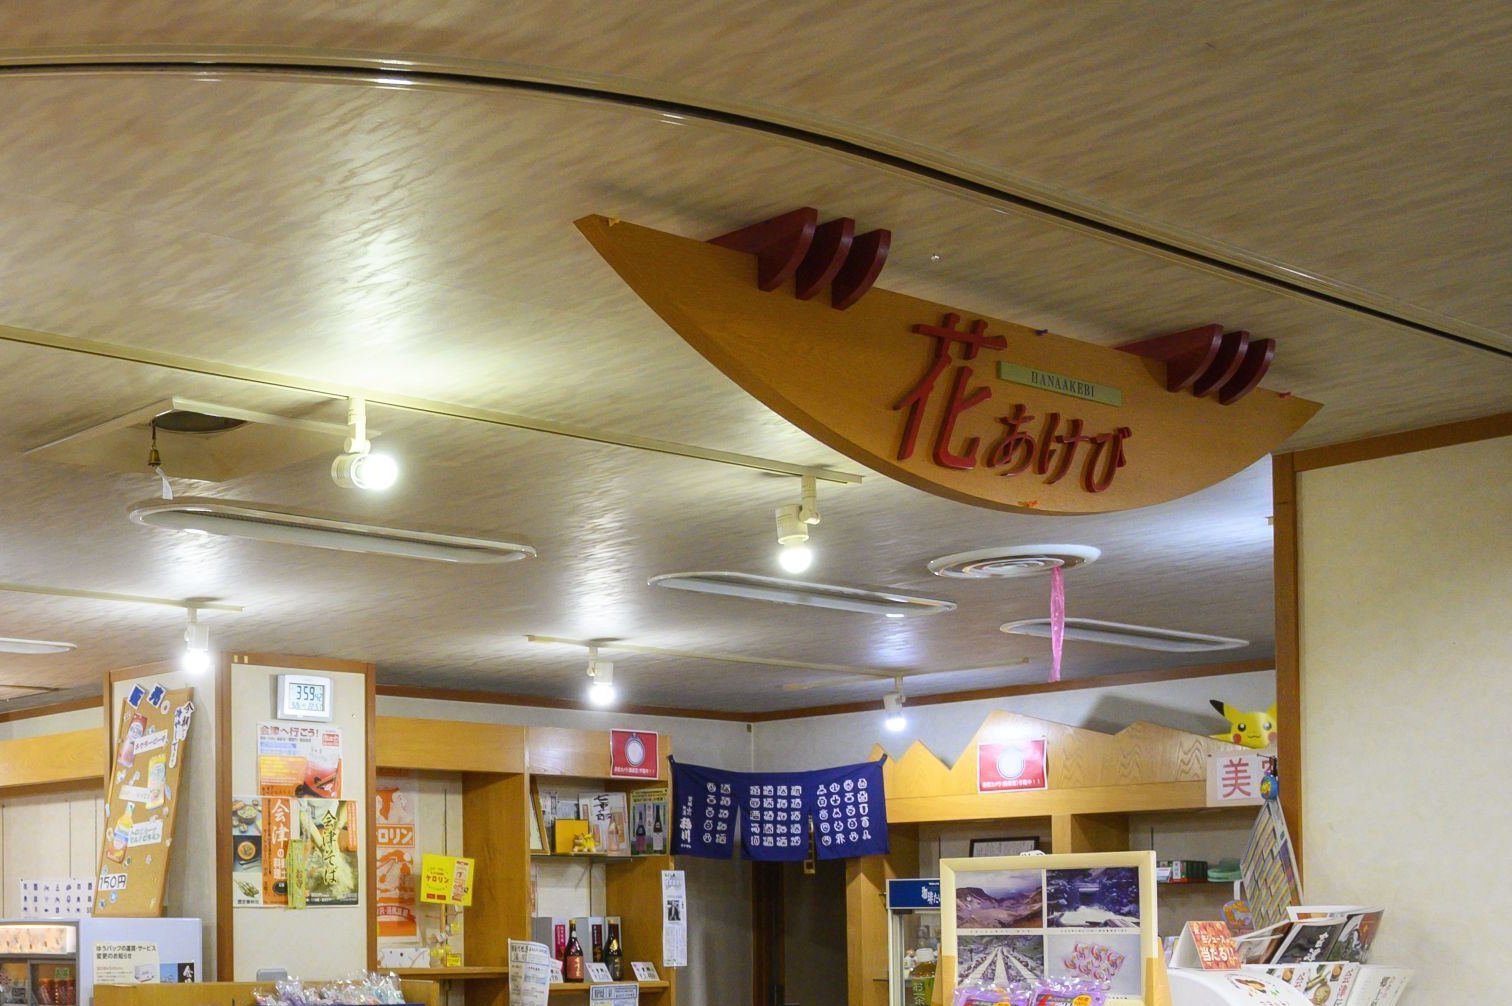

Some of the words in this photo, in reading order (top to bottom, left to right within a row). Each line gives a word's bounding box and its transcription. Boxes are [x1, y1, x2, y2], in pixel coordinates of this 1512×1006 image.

[1031, 370, 1095, 398] HANAAKEBI
[892, 312, 1132, 493] 花あけび
[322, 809, 337, 885] 会津そば
[376, 827, 414, 846] ロリン
[100, 874, 127, 889] 150円
[96, 952, 132, 960] 変更のお知らせ
[913, 982, 925, 1005] お茶
